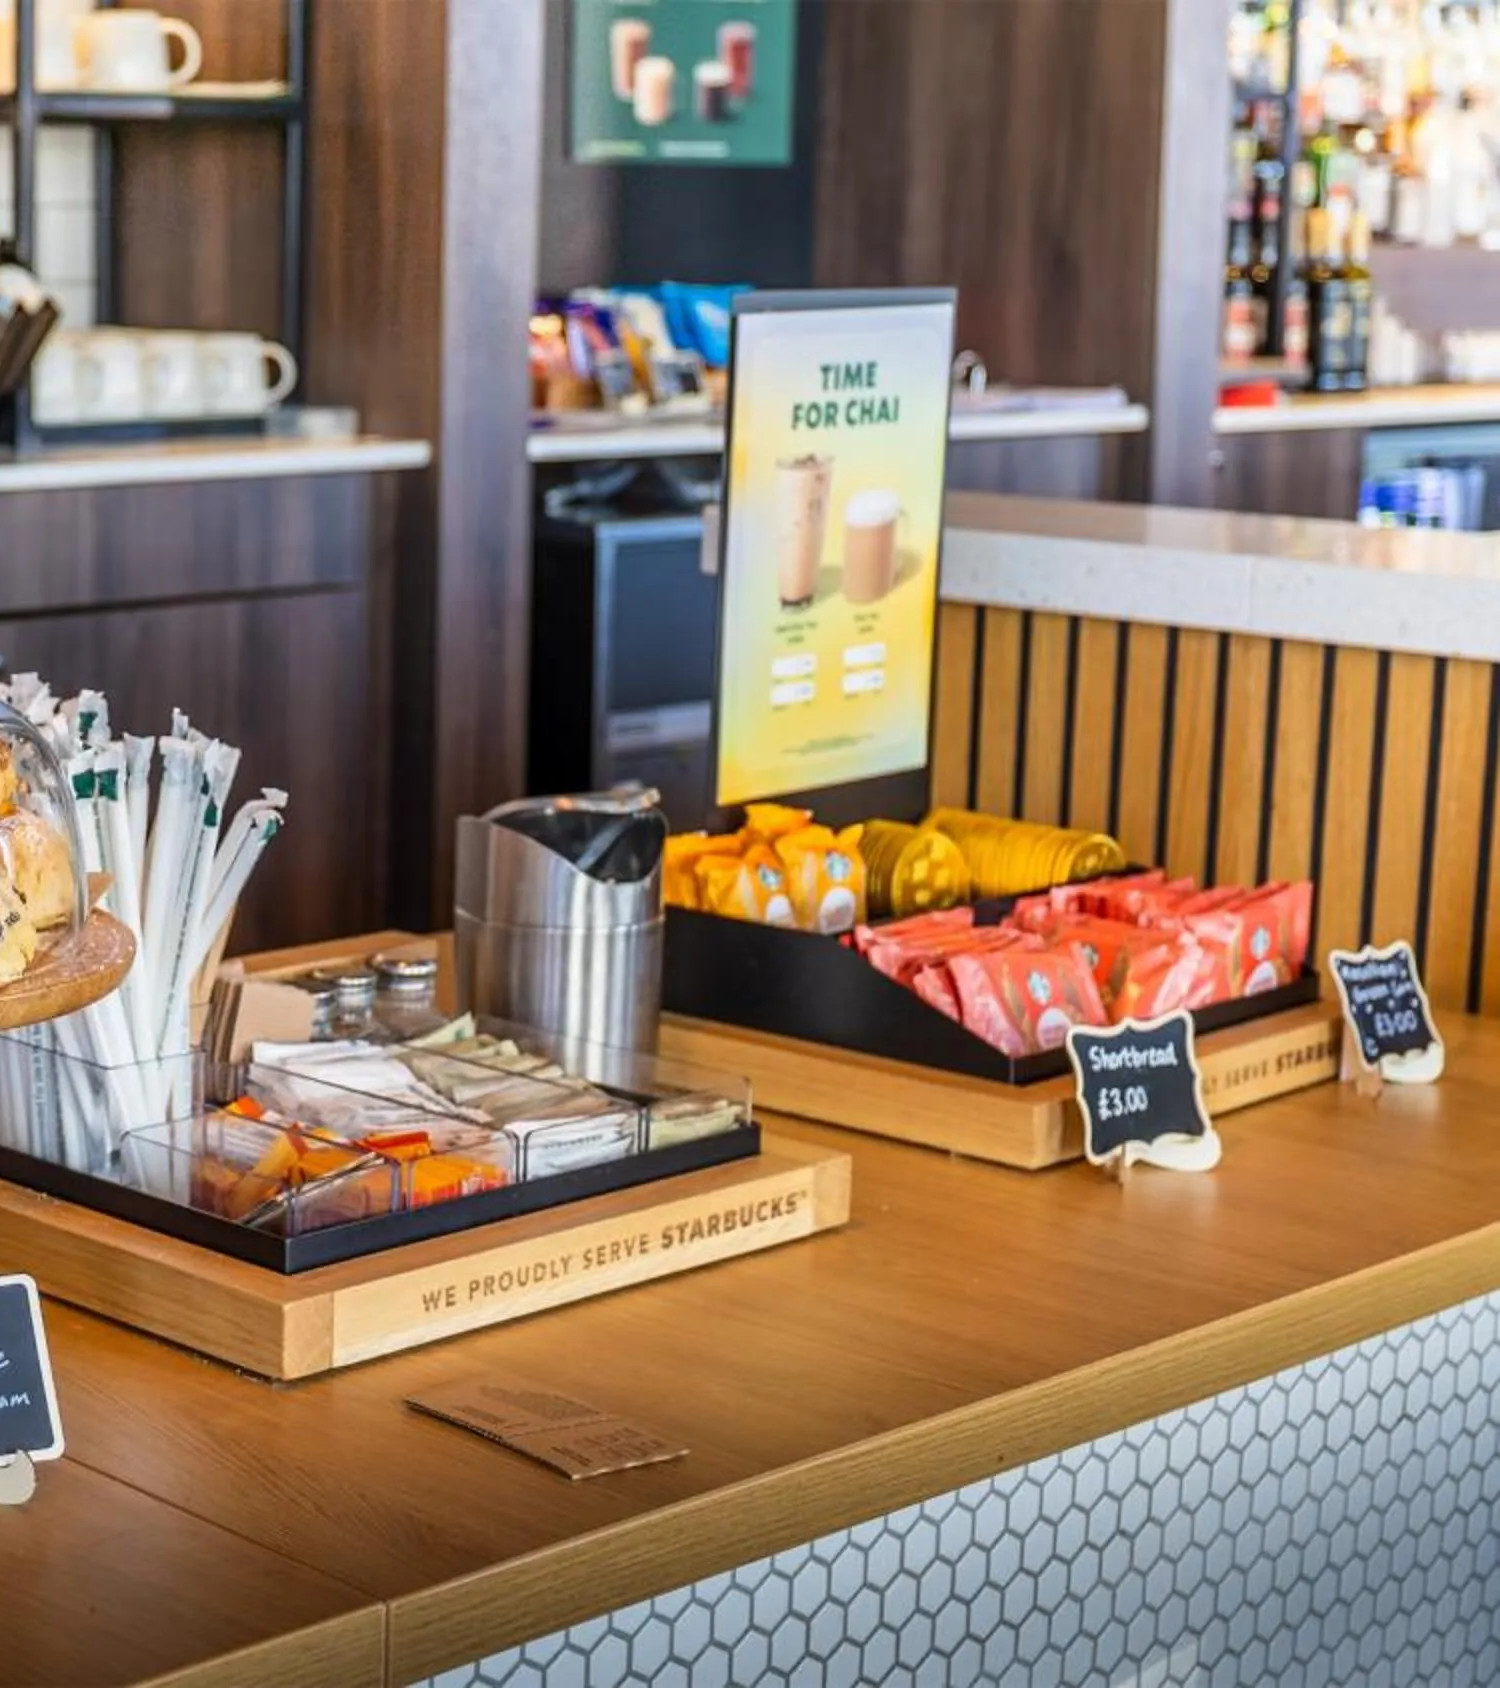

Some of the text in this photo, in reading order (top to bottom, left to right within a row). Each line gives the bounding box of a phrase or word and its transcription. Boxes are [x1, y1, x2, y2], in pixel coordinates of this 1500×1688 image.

[820, 361, 877, 391] TIME
[791, 396, 899, 430] FOR CHAI
[1089, 1043, 1178, 1071] Shortbread
[1098, 1085, 1148, 1120] £3.00
[421, 1193, 802, 1313] WE PROUDLY SERVE STARBUCKS
